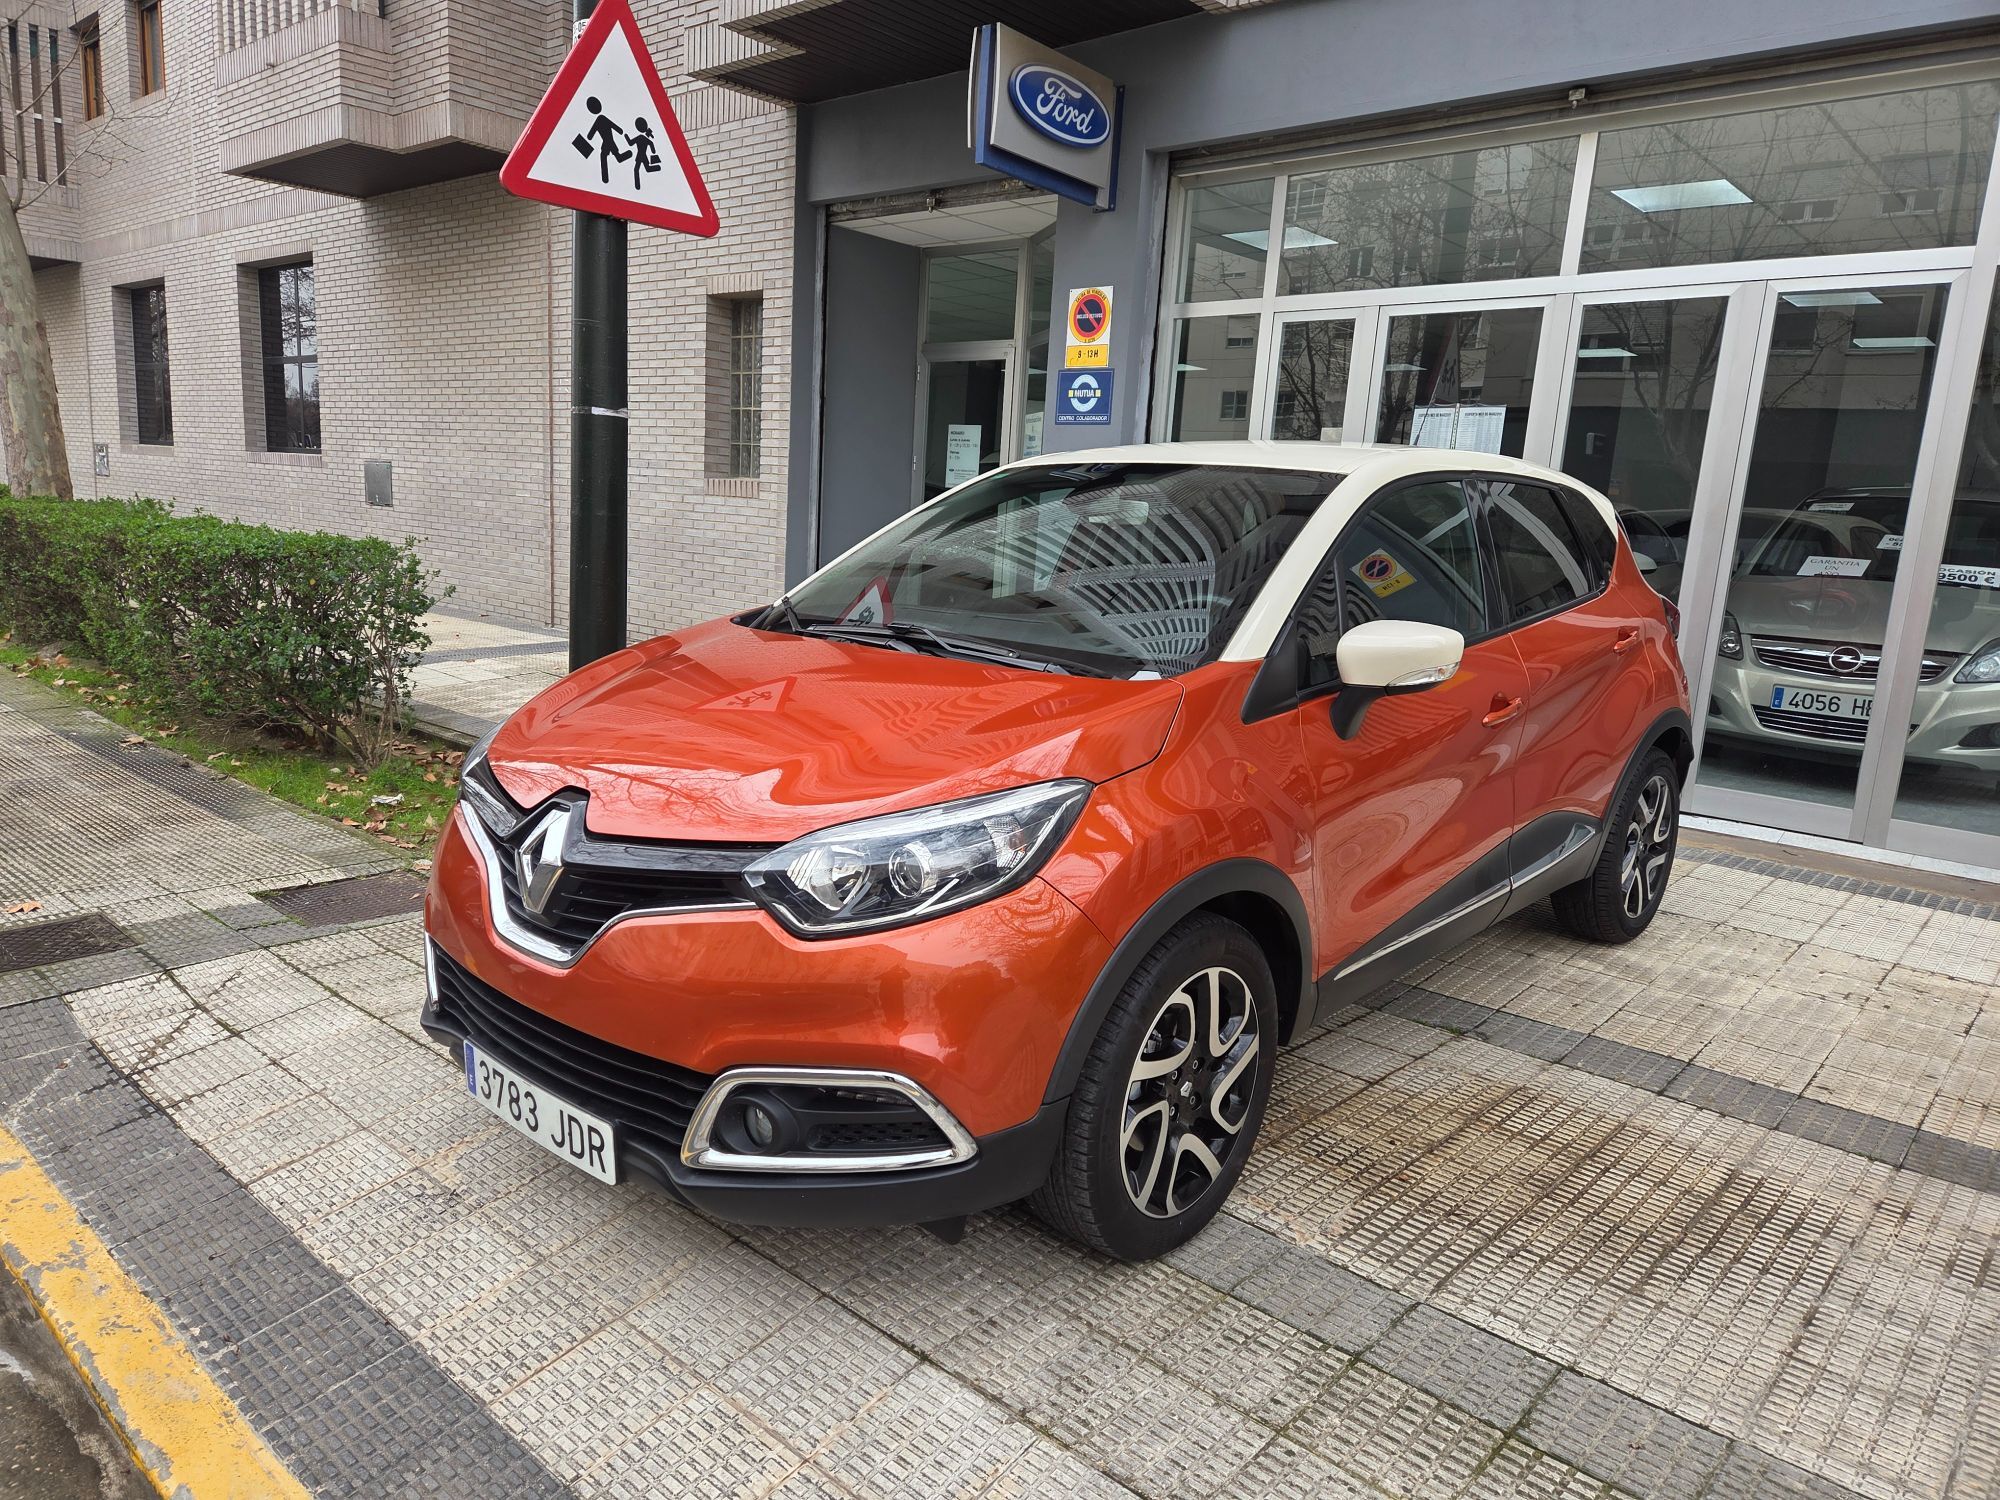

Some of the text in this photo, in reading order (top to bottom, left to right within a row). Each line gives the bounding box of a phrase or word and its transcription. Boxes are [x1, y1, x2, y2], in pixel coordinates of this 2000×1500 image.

[1036, 77, 1094, 134] Ford
[1810, 558, 1860, 567] GARANTIA
[1984, 576, 1995, 584] €
[1788, 692, 1841, 713] 4056
[479, 1060, 539, 1133] 3783
[551, 1109, 607, 1174] JDR
